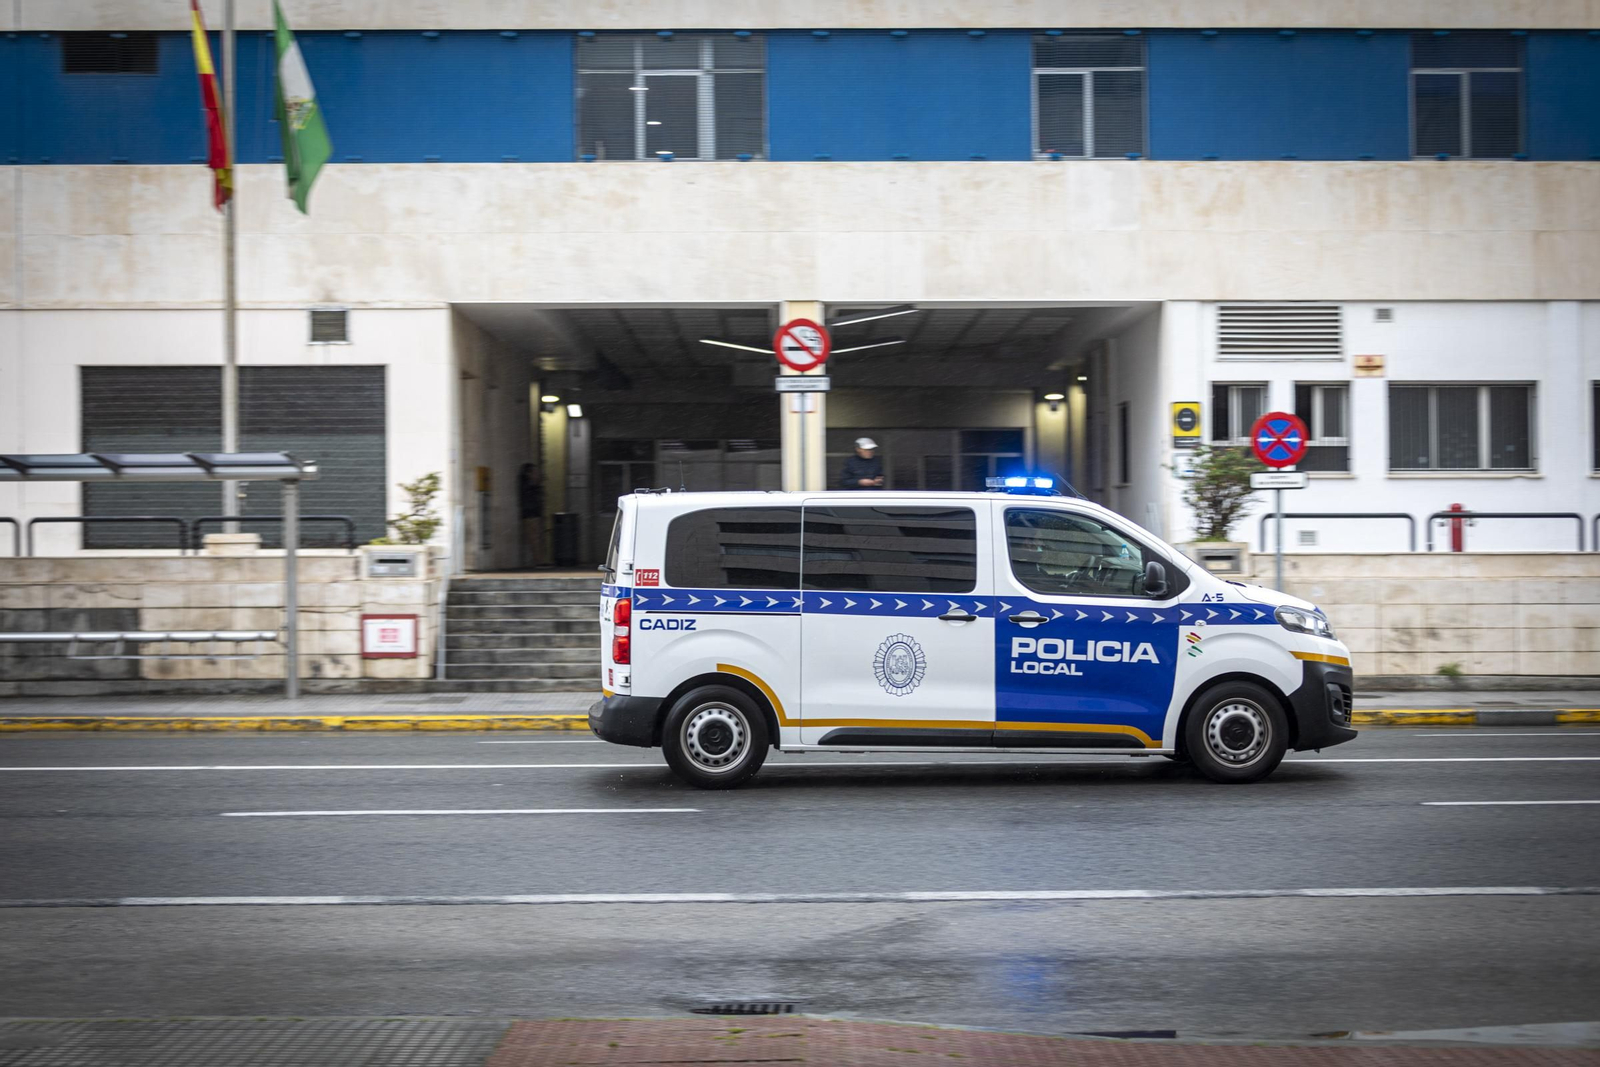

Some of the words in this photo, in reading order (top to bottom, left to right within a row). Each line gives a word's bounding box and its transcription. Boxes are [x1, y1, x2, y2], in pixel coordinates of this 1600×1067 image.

[1202, 593, 1224, 602] A-5
[640, 619, 696, 630] CADIZ
[1011, 637, 1160, 663] POLICIA
[1010, 661, 1083, 676] LOCAL
